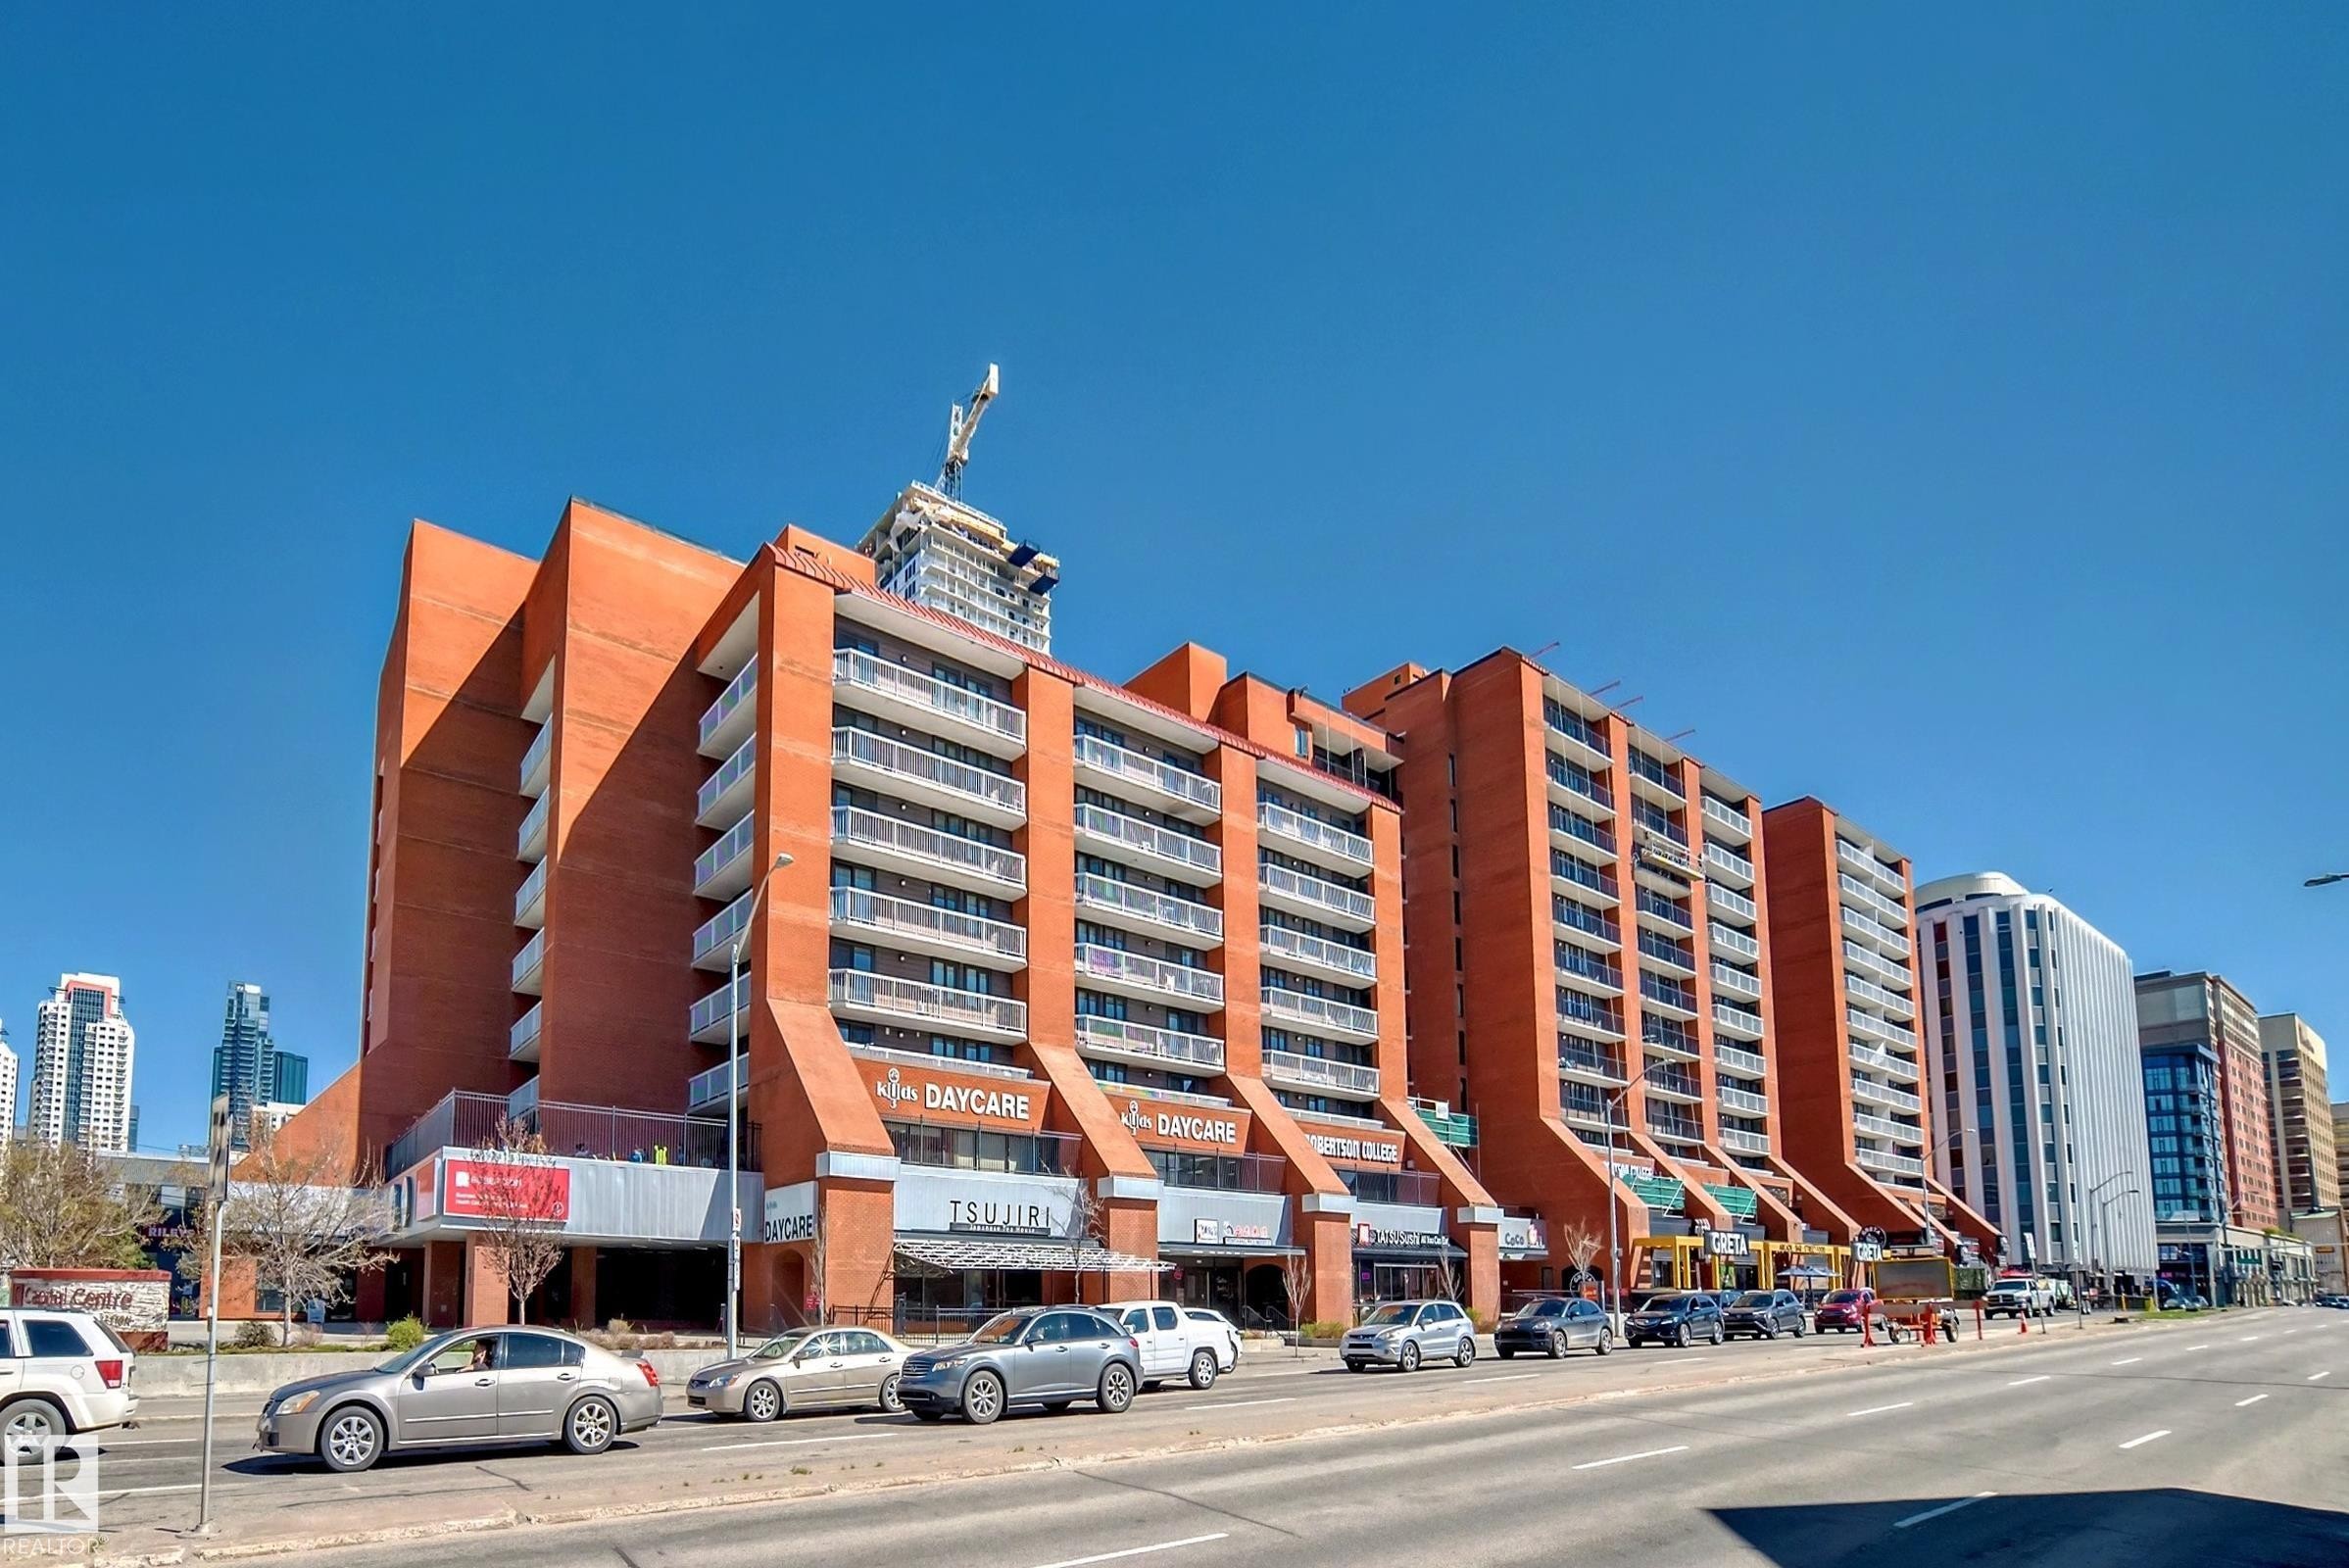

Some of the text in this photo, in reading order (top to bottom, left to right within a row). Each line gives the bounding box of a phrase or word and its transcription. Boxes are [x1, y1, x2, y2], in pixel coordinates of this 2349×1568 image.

[925, 1082, 1030, 1119] DAYCARE
[1157, 1113, 1237, 1143] DAYCARE
[1362, 1141, 1397, 1162] COLLEGE
[950, 1200, 1050, 1227] TSUJIRI
[765, 1215, 813, 1242] DAYCARE
[1712, 1232, 1748, 1255] GRETA
[1857, 1243, 1883, 1261] GRETA
[71, 1287, 133, 1310] Centre
